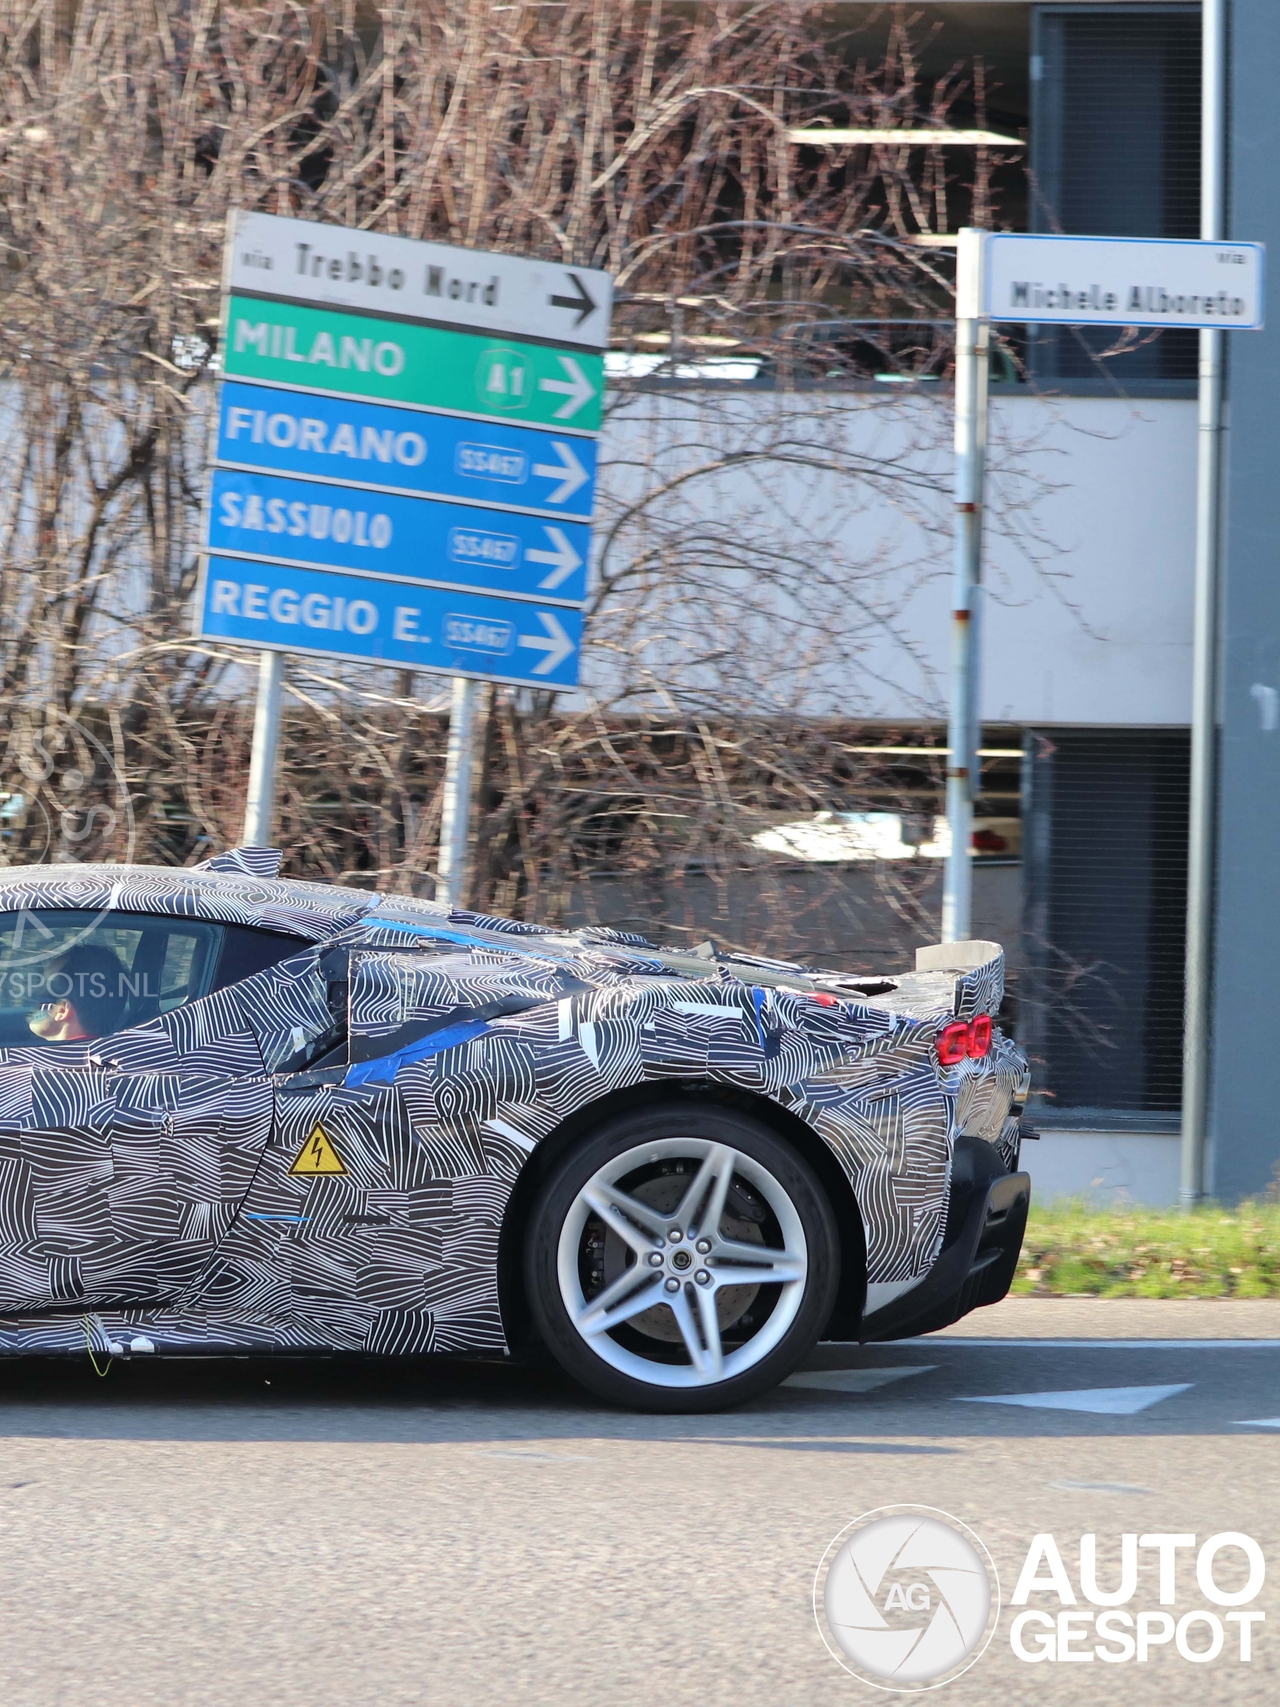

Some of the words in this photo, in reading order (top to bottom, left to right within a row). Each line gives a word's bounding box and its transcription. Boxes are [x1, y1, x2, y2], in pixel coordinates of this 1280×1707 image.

[240, 249, 274, 271] via
[295, 243, 405, 291] Trebbo
[424, 264, 500, 307] Nord
[1216, 250, 1247, 265] via
[1010, 281, 1117, 311] Michele
[1126, 285, 1245, 316] Alboreto
[233, 319, 406, 377] MILANO
[485, 363, 525, 397] A1
[225, 406, 428, 467] FIORANO
[459, 449, 525, 477] SS467
[219, 492, 393, 549] SASSUOLO
[452, 534, 518, 562] SS467
[211, 580, 379, 635] REGGIO
[393, 607, 432, 645] E.
